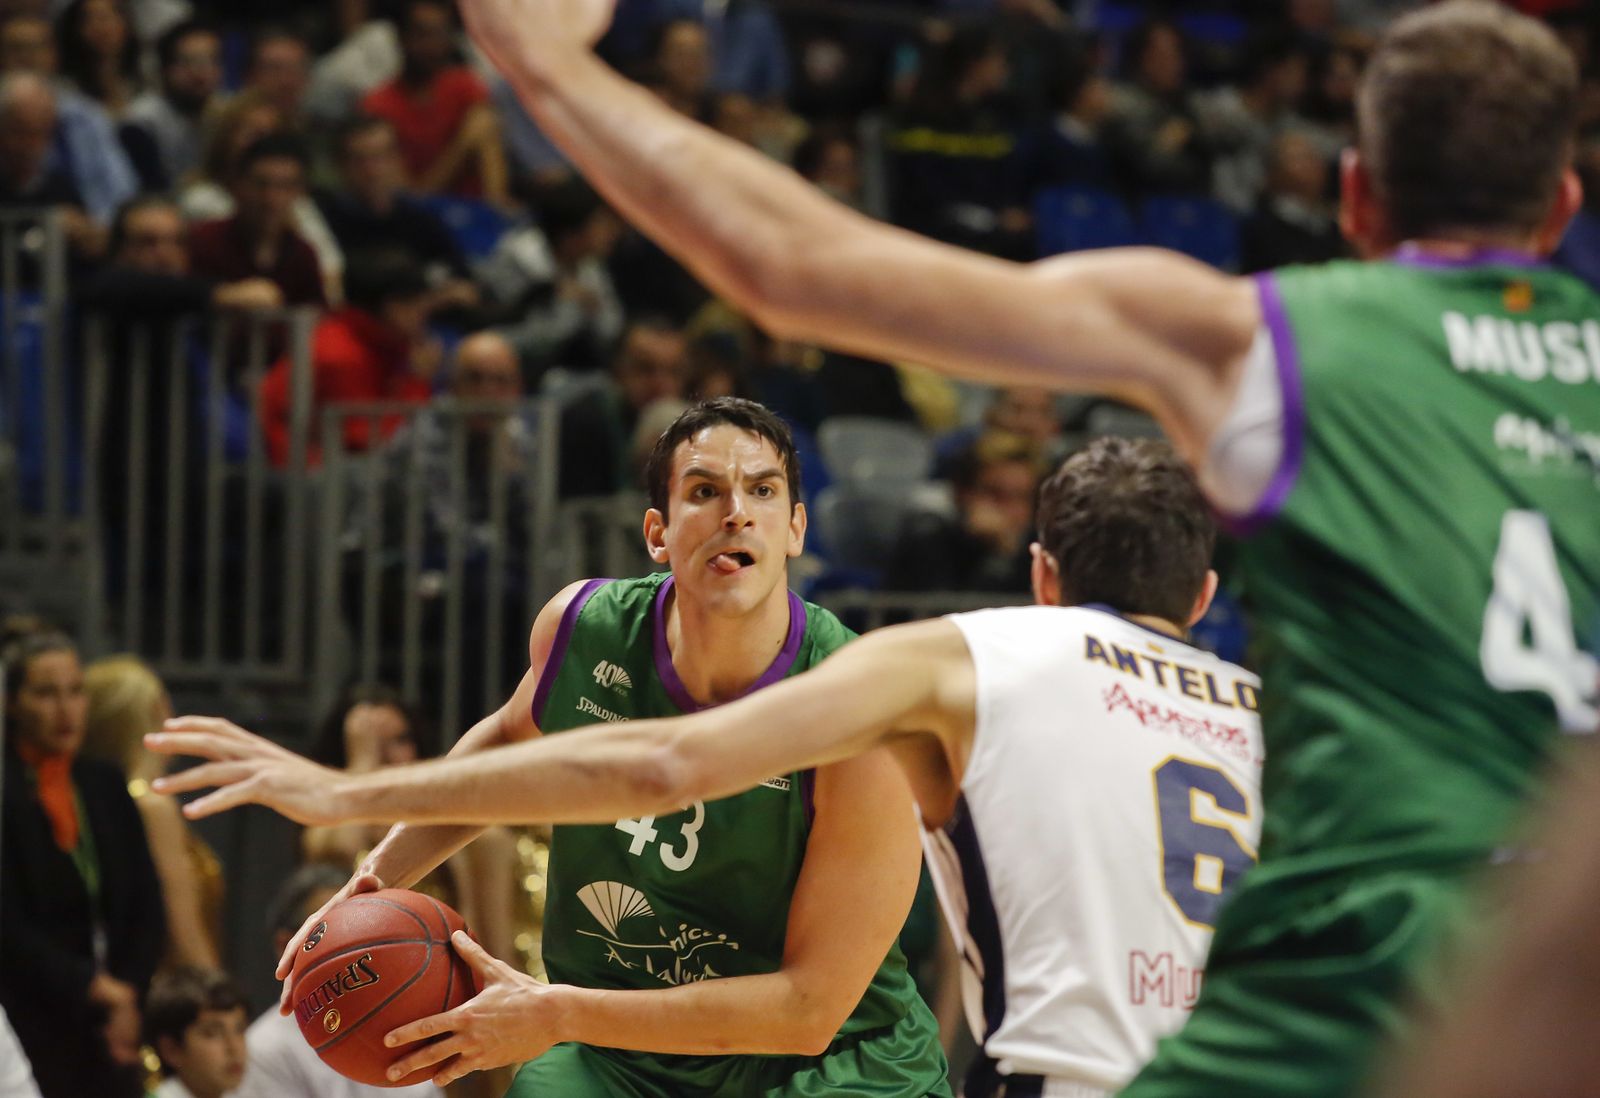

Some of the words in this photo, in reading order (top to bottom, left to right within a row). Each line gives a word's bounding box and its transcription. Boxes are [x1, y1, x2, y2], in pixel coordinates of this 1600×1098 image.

[1478, 508, 1600, 733] 4
[575, 696, 630, 723] SPALDIN
[1084, 633, 1261, 711] ANTELO
[615, 798, 705, 872] 43
[1151, 754, 1259, 932] 6
[298, 952, 380, 1024] SPALDI
